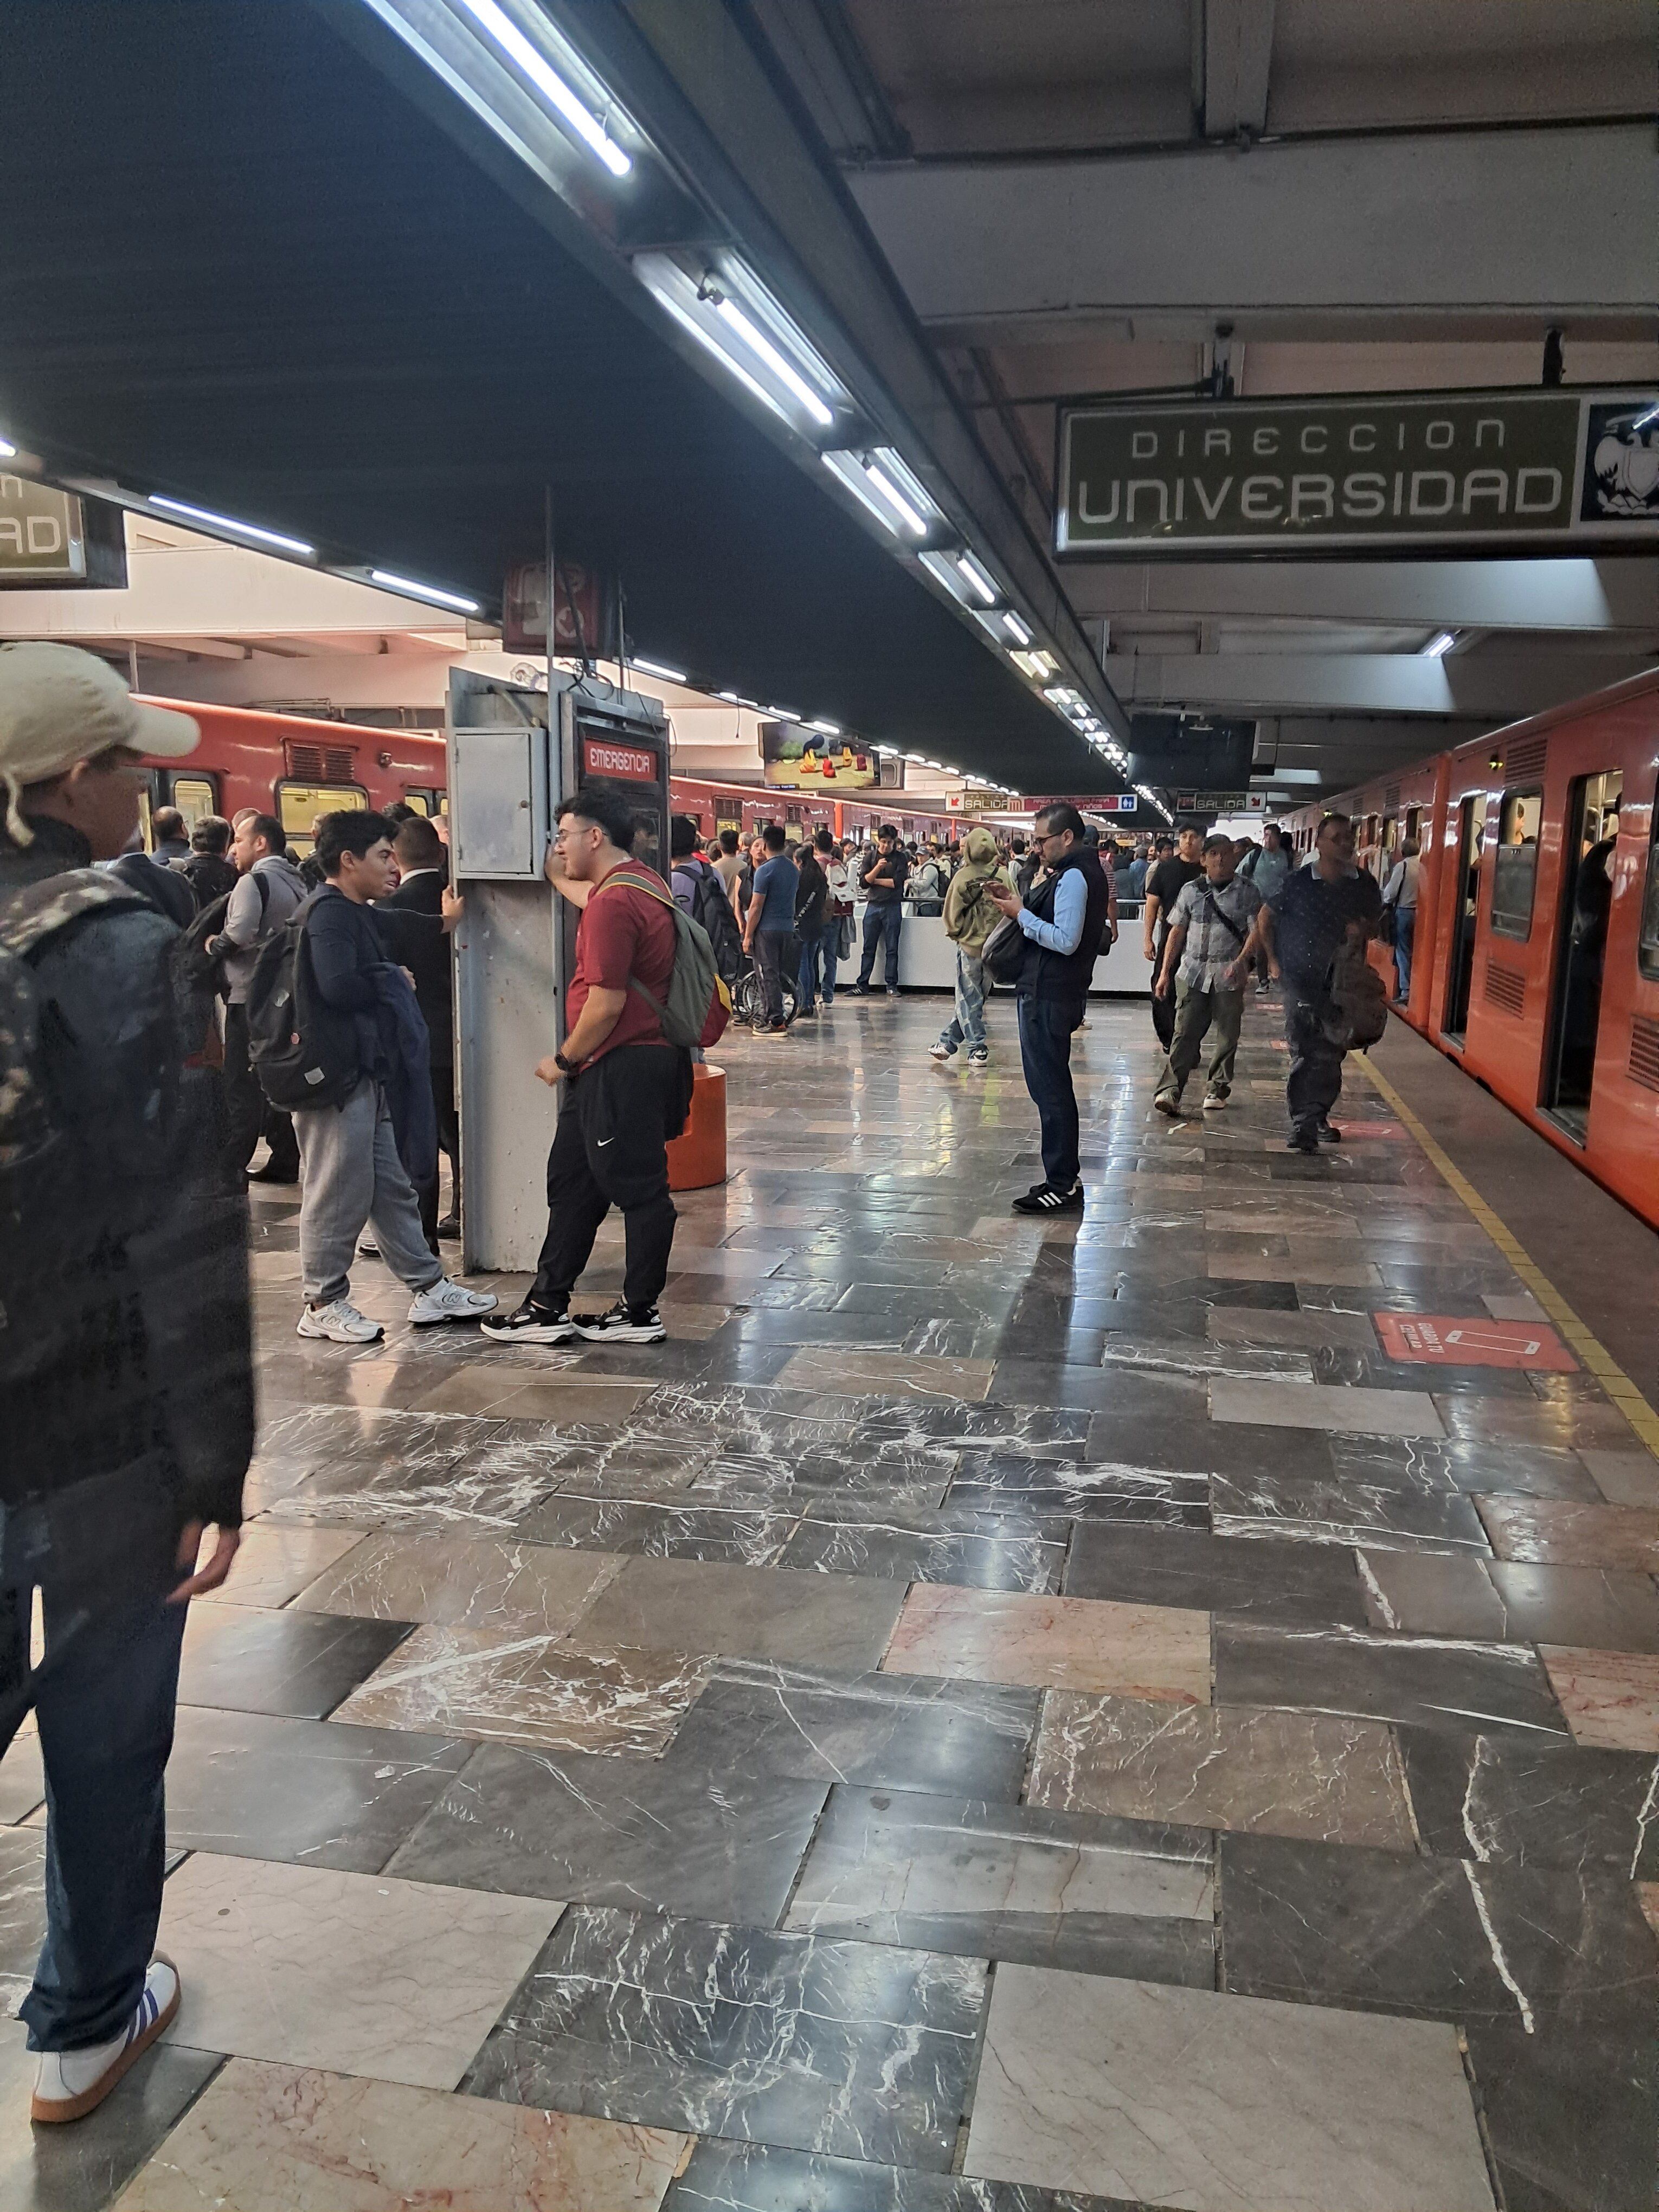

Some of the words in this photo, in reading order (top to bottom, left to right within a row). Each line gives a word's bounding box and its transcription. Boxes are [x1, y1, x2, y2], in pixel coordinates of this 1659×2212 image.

[1131, 418, 1506, 458] DIRECCION
[1078, 466, 1562, 524] UNIVERSIDAD
[0, 516, 61, 554] AD
[590, 748, 650, 773] EMERGENCIA
[965, 800, 1007, 808] SALIDA
[1197, 800, 1245, 809] SALIDA
